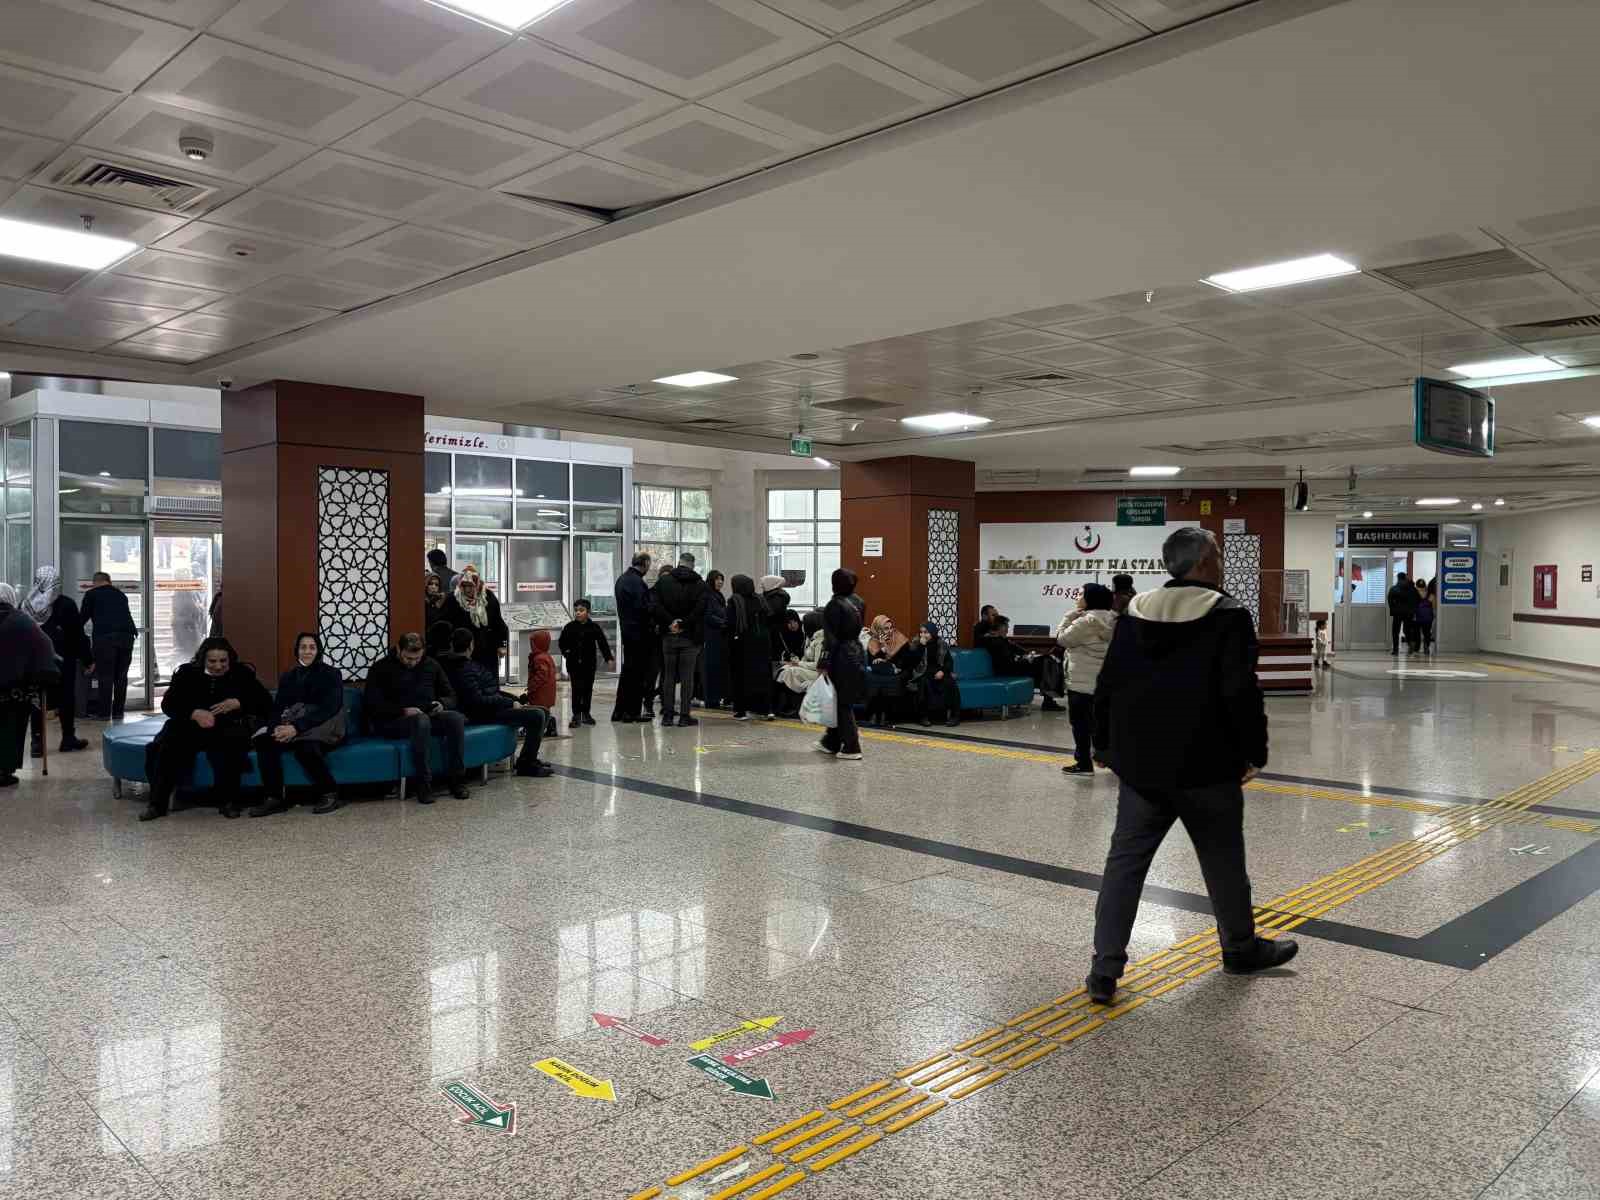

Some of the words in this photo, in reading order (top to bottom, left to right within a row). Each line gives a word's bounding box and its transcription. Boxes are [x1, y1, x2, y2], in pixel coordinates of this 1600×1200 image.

[425, 432, 488, 448] lerimizle.
[1356, 530, 1431, 542] BAŞHEKİMLİK
[1046, 559, 1104, 574] DEVLET
[1106, 558, 1169, 574] HASTAN
[1041, 584, 1082, 600] Hoşg
[734, 1040, 783, 1060] KETEM
[448, 1086, 476, 1103] ÇOCUK
